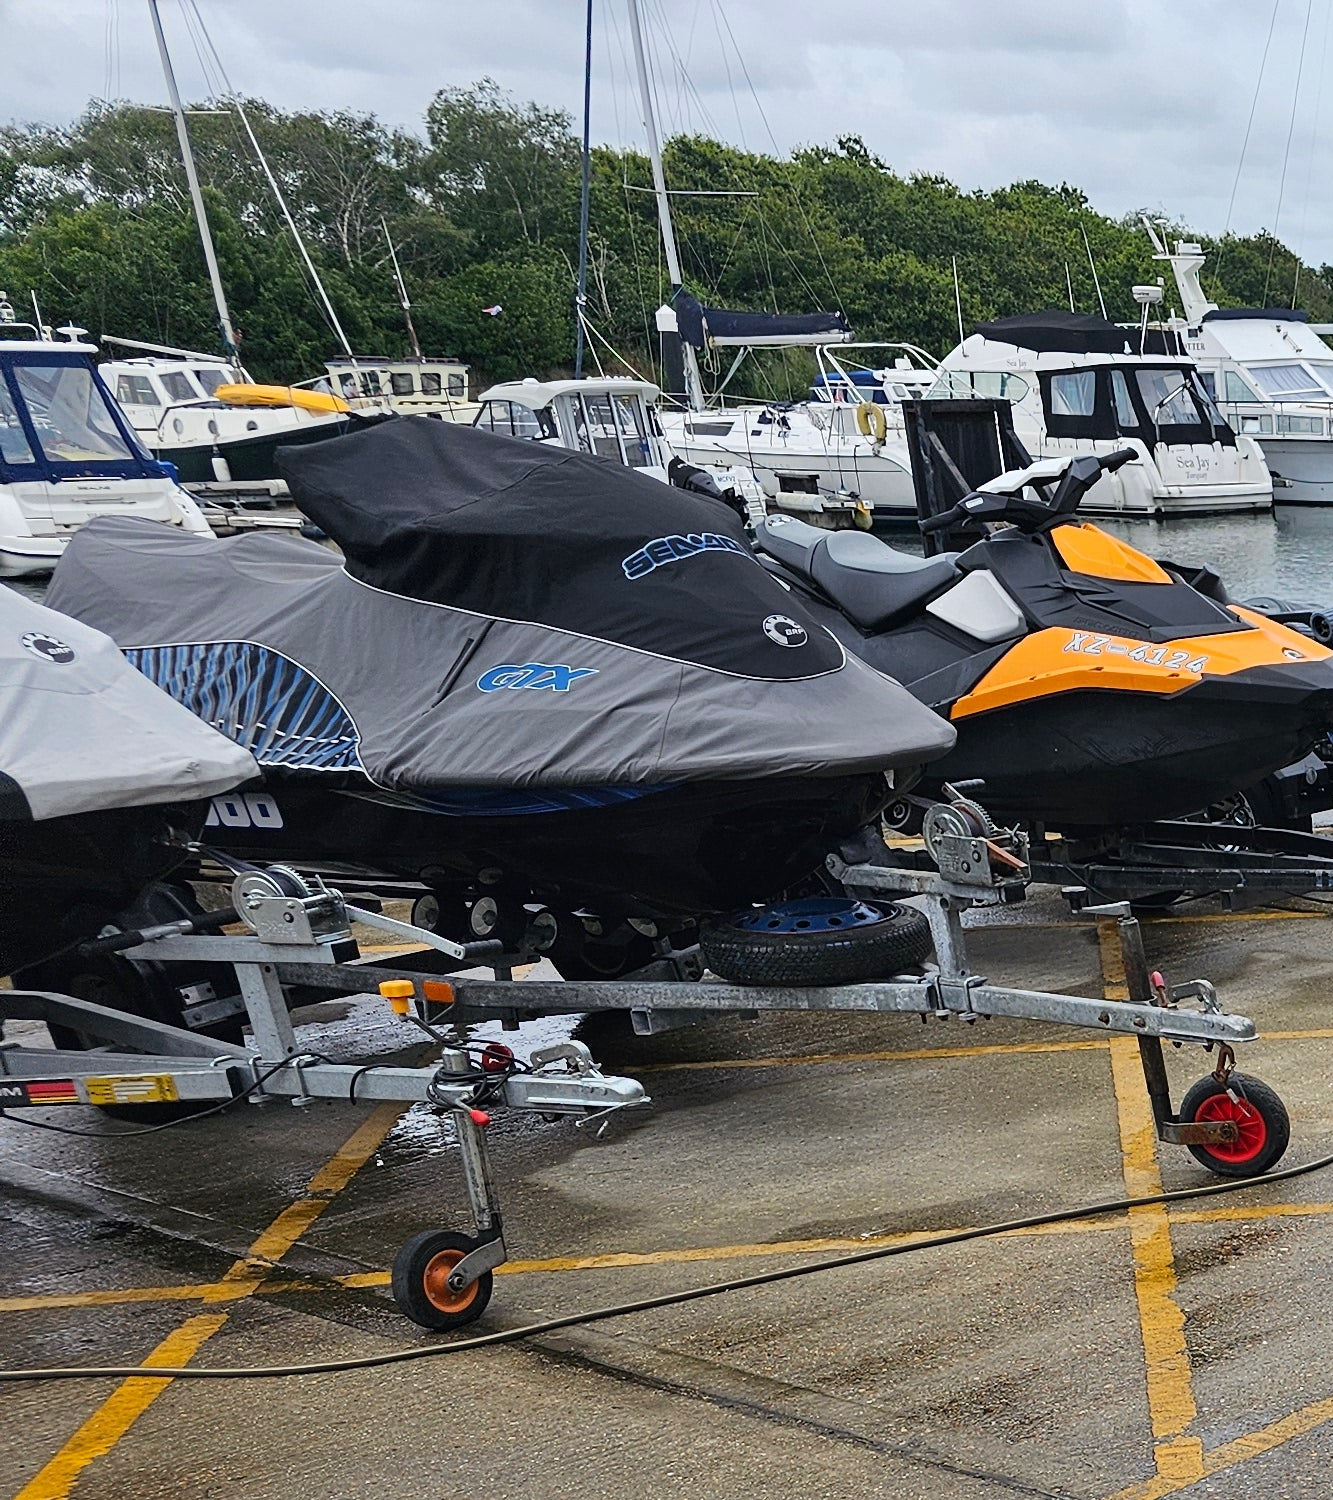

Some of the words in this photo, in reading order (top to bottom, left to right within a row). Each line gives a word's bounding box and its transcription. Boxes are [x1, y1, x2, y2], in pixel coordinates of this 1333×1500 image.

[1177, 456, 1194, 469] Sea
[1195, 456, 1210, 472] Jay
[476, 662, 600, 693] GTX
